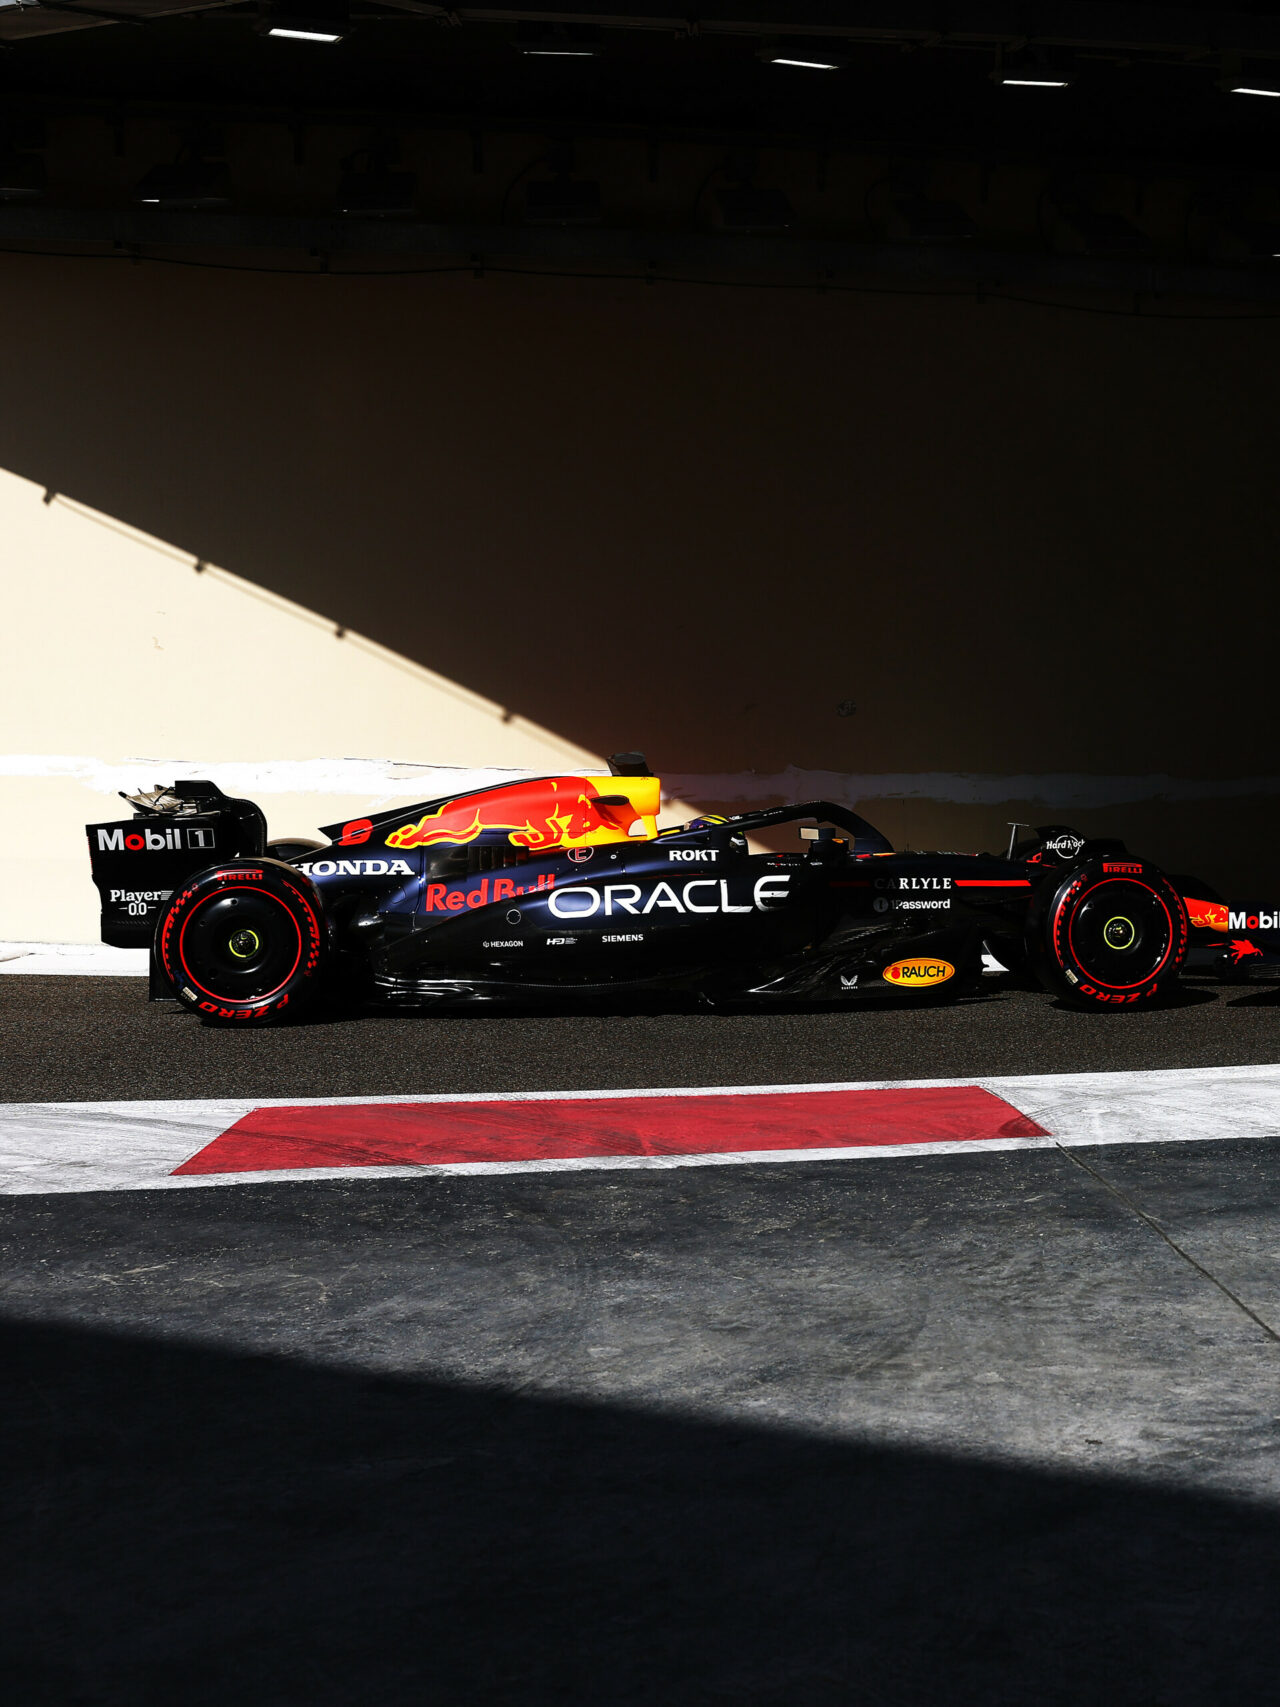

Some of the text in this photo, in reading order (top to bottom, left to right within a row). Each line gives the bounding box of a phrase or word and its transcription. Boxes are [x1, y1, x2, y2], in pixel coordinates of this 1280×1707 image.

[97, 828, 182, 851] Mobil
[1046, 840, 1067, 850] Hard
[575, 847, 587, 860] E
[669, 850, 719, 862] ROKT
[290, 860, 415, 876] HONDA
[1102, 862, 1143, 874] PIRELLI
[216, 869, 264, 881] PIRELLI
[873, 877, 952, 889] CARLYLE
[425, 879, 489, 912] Red
[547, 875, 791, 919] ORACLE
[490, 940, 524, 948] HEXAGON
[602, 934, 644, 943] SIEMENS
[902, 966, 946, 978] RAUCH
[1079, 984, 1142, 1004] ZERO
[199, 994, 289, 1019] P ZERO
